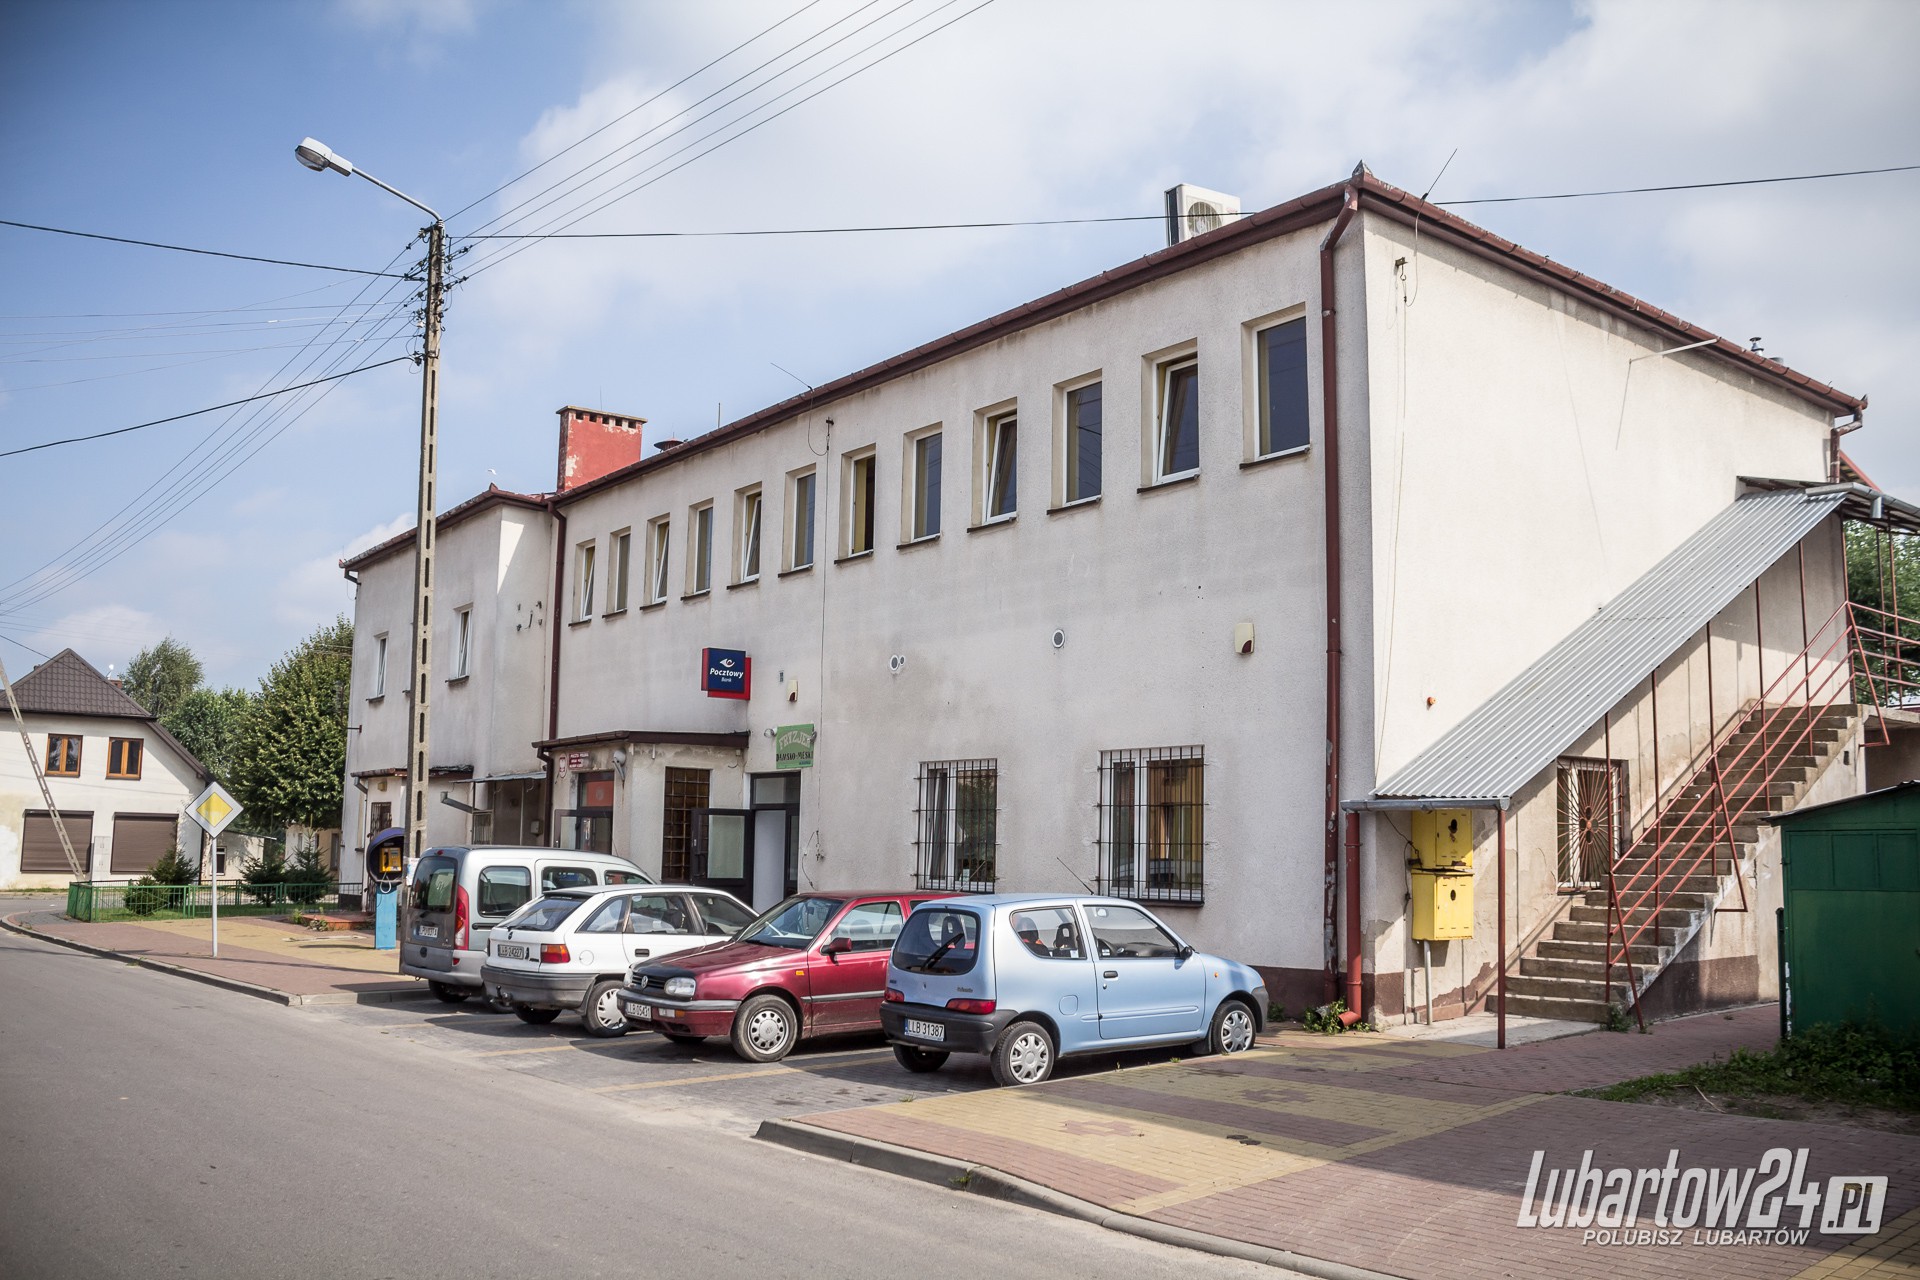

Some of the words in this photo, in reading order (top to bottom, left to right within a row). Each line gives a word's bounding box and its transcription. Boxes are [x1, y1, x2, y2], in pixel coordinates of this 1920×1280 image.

[709, 668, 744, 679] Pocztowy
[908, 1020, 920, 1034] LLB
[922, 1023, 944, 1038] 31387
